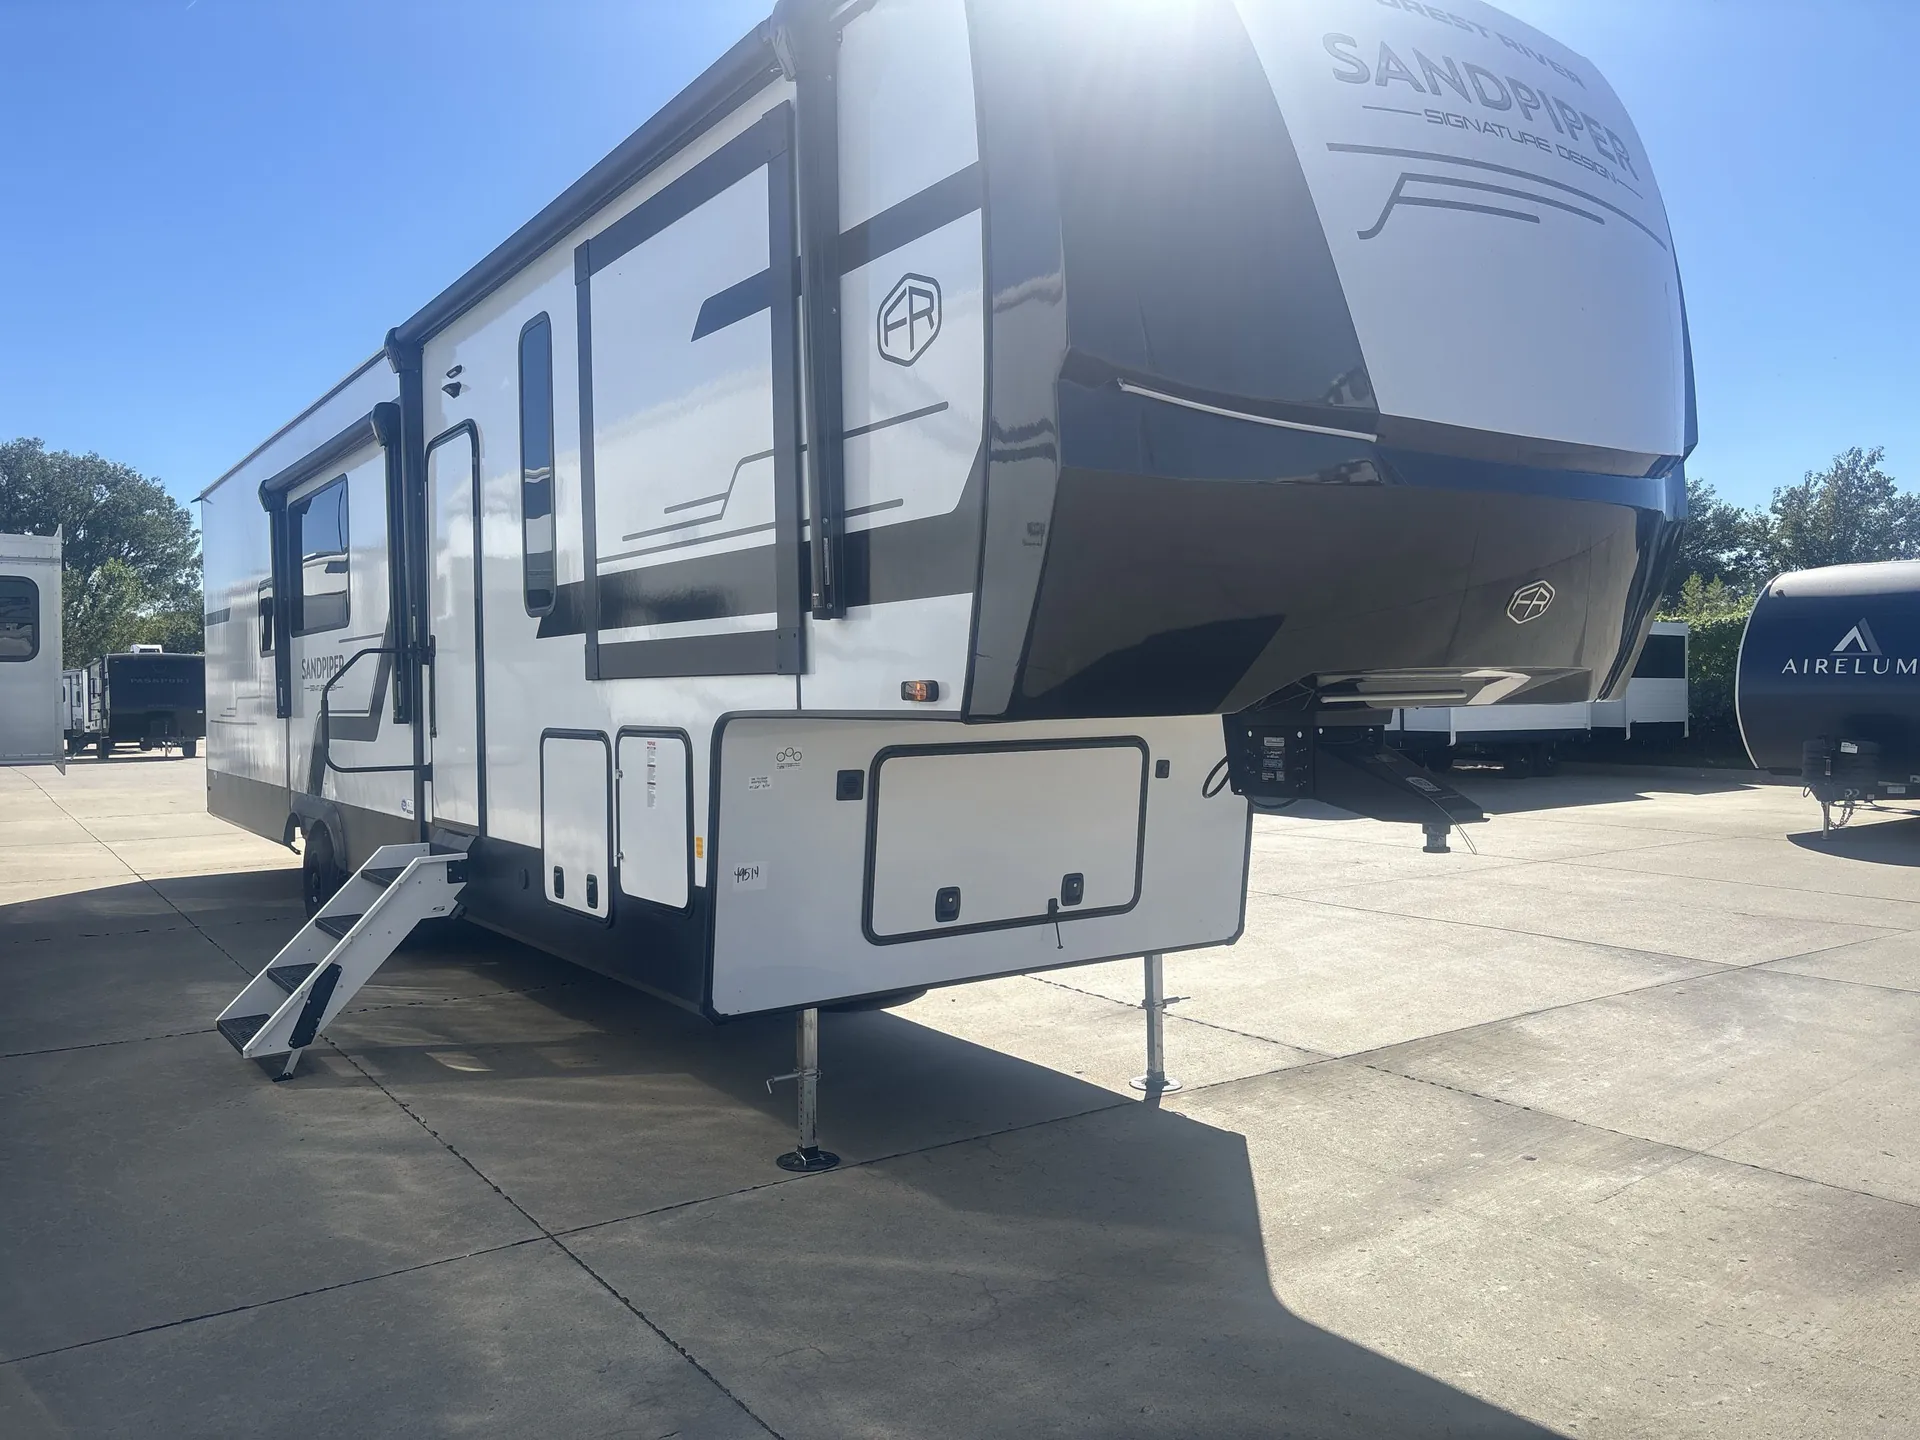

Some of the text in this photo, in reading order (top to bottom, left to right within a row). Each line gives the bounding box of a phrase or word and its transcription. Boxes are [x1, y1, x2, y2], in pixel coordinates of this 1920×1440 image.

[1495, 31, 1588, 91] RIVER
[1322, 32, 1640, 181] SANDPIPER
[1424, 108, 1617, 185] SIGNATURE DESIGN
[1781, 657, 1918, 675] AIRELUM
